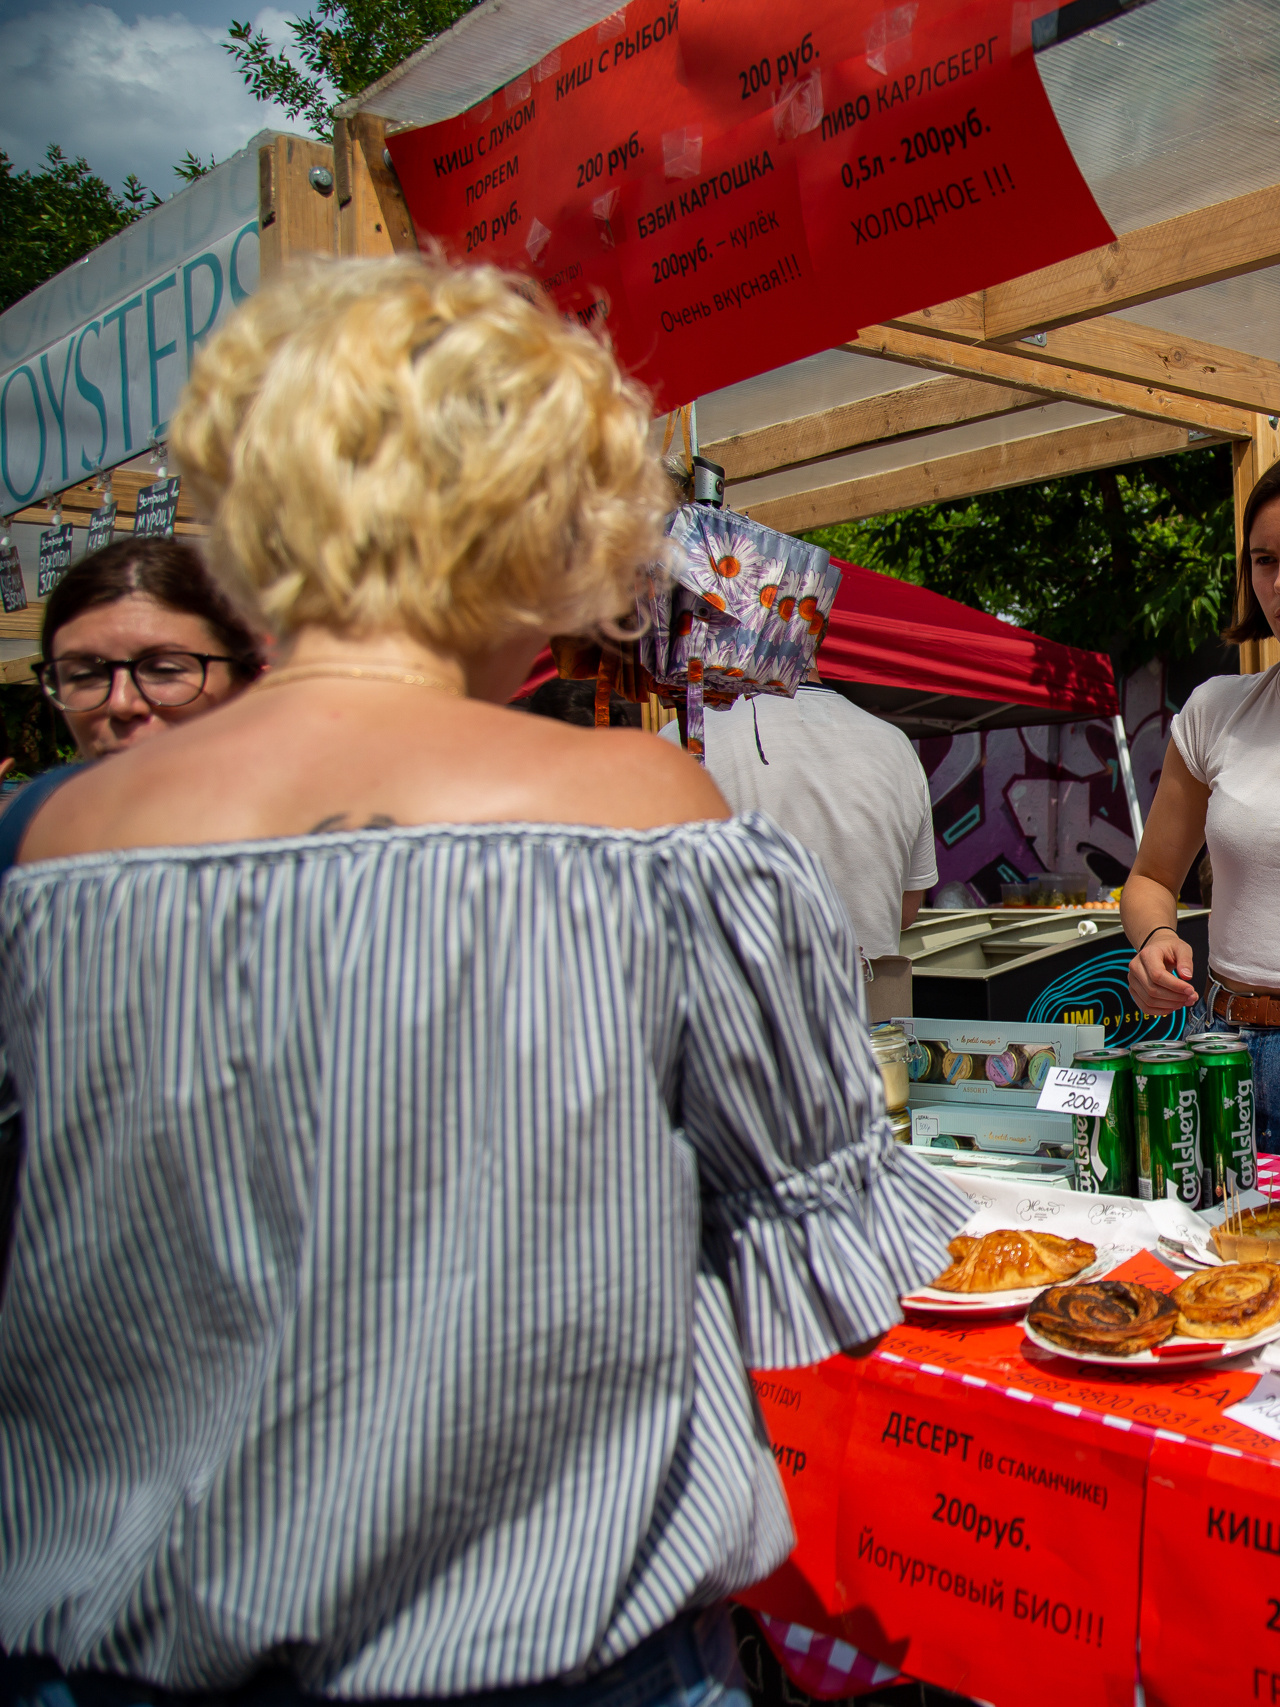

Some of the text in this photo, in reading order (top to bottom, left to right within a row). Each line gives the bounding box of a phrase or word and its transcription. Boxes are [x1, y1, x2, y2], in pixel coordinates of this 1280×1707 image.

[556, 1, 679, 101] КИШ С РЫБОЙ
[739, 32, 820, 100] 200 руб.
[821, 35, 998, 142] ПИВО КАРЛСБЕРГ
[433, 100, 536, 177] КИШ С ЛУКОМ
[577, 131, 644, 188] 200 руб.
[841, 155, 885, 190] 0,5л
[900, 107, 991, 165] 200руб.
[466, 155, 519, 206] ПОРЕЕМ
[637, 150, 774, 239] БЭБИ КАРТОШКА
[851, 177, 981, 245] ХОЛОДНОЕ
[466, 201, 521, 253] 200 руб.
[652, 238, 713, 284] 200руб.
[729, 210, 780, 249] кулёк
[661, 253, 802, 332] Очень вкусная!!!
[1055, 1069, 1098, 1086] ПИВО
[1167, 1089, 1203, 1211] Carlsberg
[774, 1442, 807, 1476] итр
[881, 1411, 974, 1463] ДЕСЕРТ
[997, 1456, 1109, 1511] СТАКАНЧИКЕ)
[932, 1493, 1032, 1552] 200руб.
[858, 1525, 1104, 1648] Йогуртовый БИО!!!
